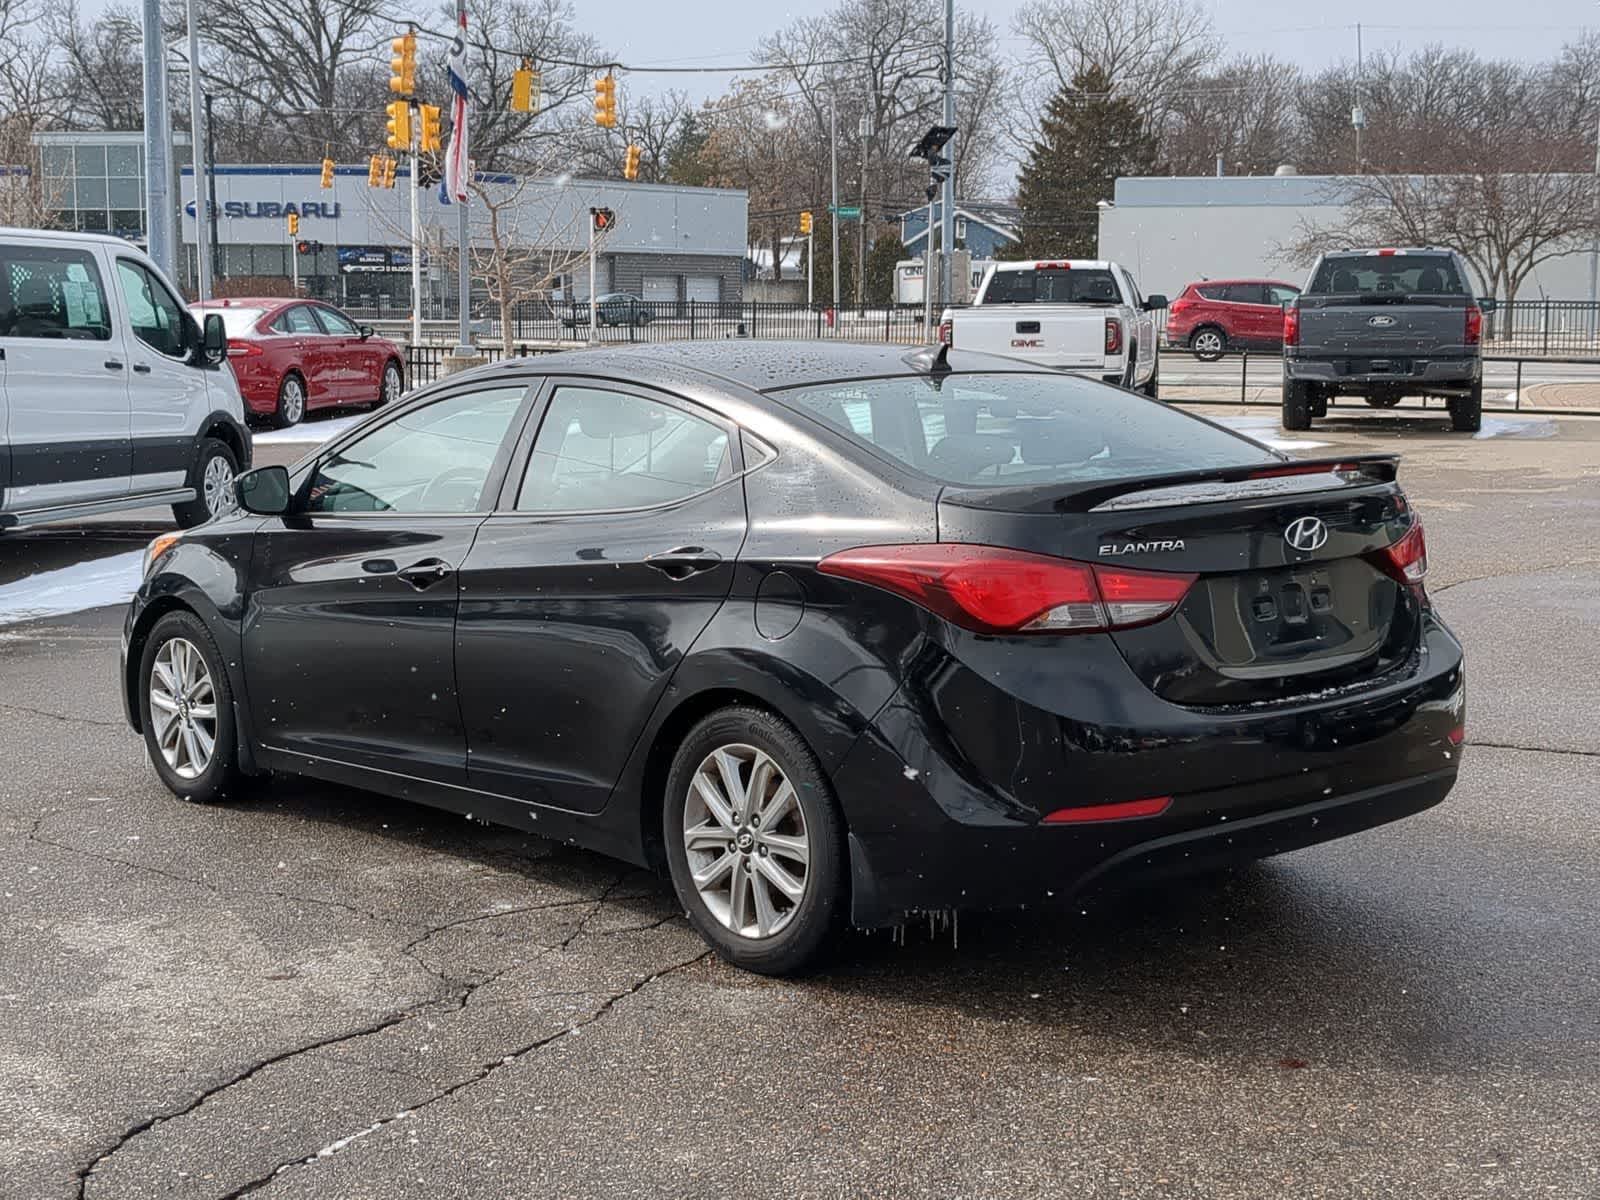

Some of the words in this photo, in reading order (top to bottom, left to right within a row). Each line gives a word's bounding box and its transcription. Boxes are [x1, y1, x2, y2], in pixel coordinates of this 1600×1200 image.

[225, 201, 341, 219] SUBARU
[1011, 339, 1045, 348] GMC
[1098, 540, 1185, 556] ELANTRA
